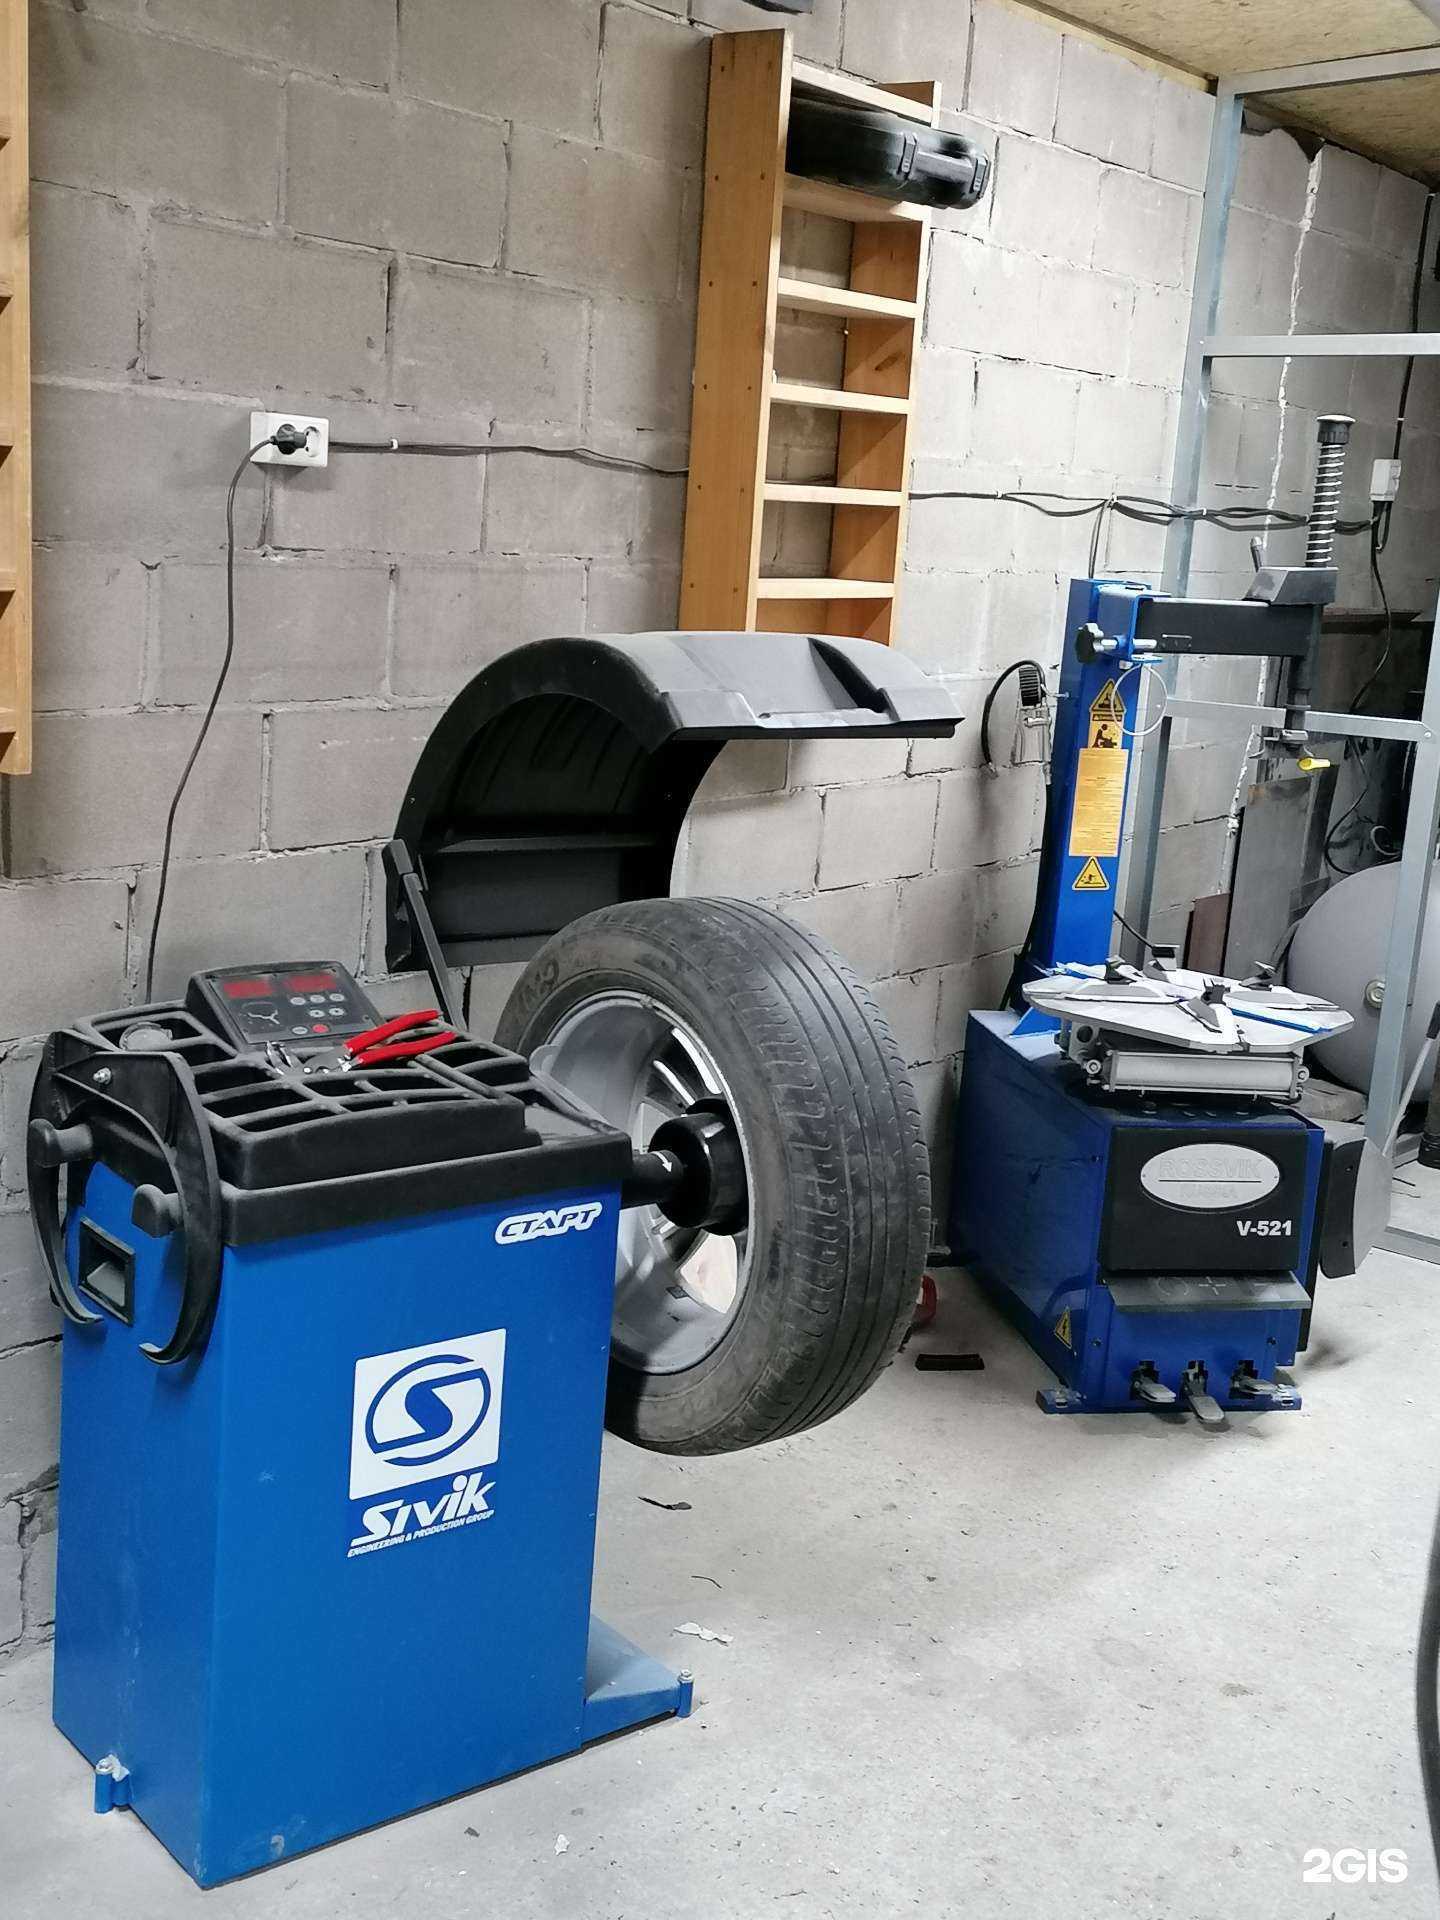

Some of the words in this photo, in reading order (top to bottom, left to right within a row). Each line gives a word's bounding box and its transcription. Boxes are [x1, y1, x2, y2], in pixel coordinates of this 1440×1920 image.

[1159, 1158, 1264, 1178] ROSSVIK
[1236, 1220, 1292, 1236] V-521
[347, 1535, 405, 1558] ENGINEERING
[413, 1518, 465, 1540] PRODUCTION
[465, 1510, 495, 1525] GROUP
